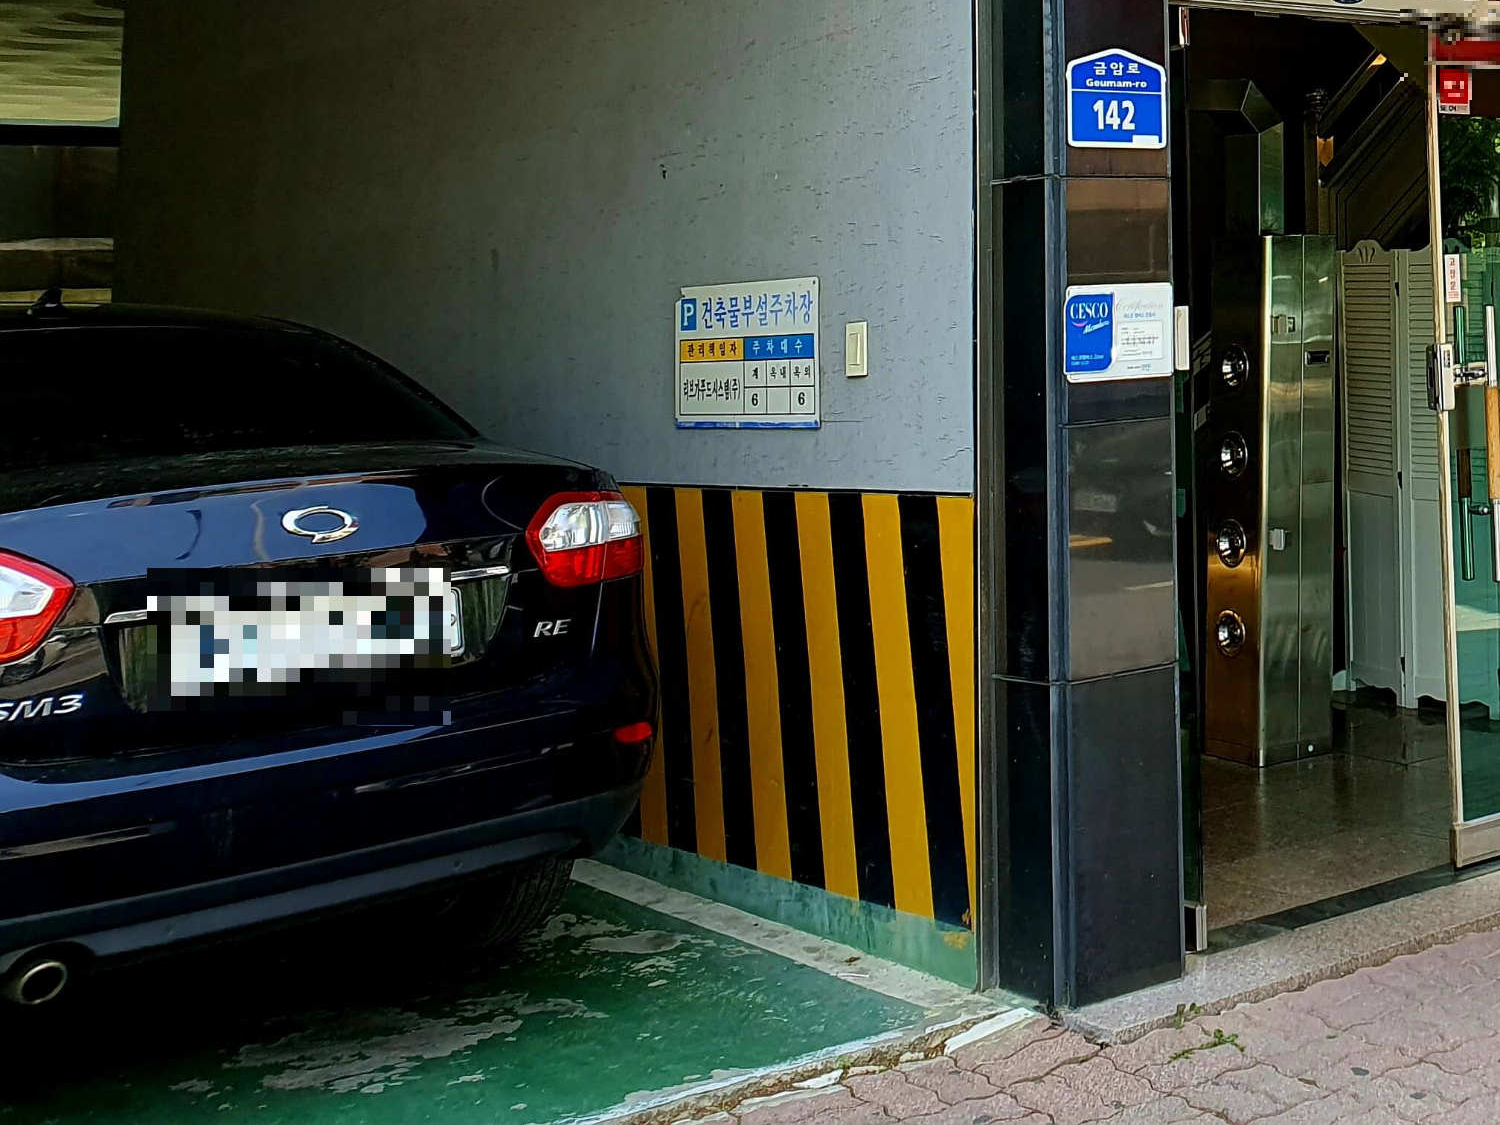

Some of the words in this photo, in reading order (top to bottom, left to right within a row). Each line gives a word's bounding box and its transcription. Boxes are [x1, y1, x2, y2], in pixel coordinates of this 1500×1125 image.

[1093, 61, 1141, 76] 금암로
[1086, 77, 1147, 89] Geumam-ro
[1093, 100, 1136, 131] 142
[683, 303, 694, 327] P
[701, 290, 813, 330] 건축물부설주차장
[1070, 302, 1108, 320] CESCO
[751, 392, 759, 406] 6
[797, 391, 806, 406] 6
[534, 618, 570, 638] RE
[0, 693, 83, 722] SM3
